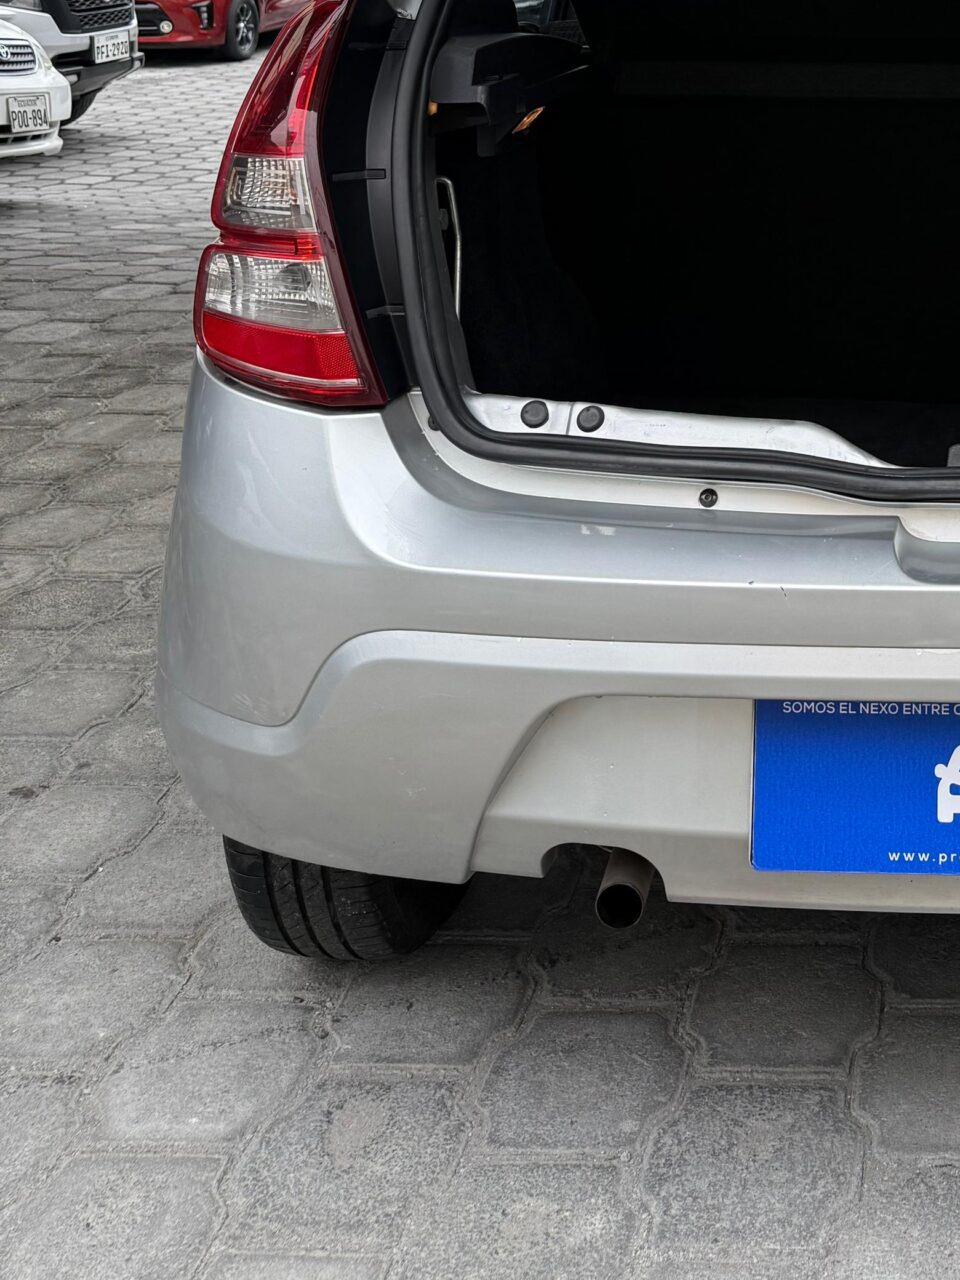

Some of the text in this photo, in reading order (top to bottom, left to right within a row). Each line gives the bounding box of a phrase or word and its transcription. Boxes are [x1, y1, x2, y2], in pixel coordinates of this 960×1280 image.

[782, 701, 836, 714] SOMOS
[839, 702, 857, 715] EL
[859, 702, 899, 716] NEXO
[902, 703, 950, 716] ENTRE
